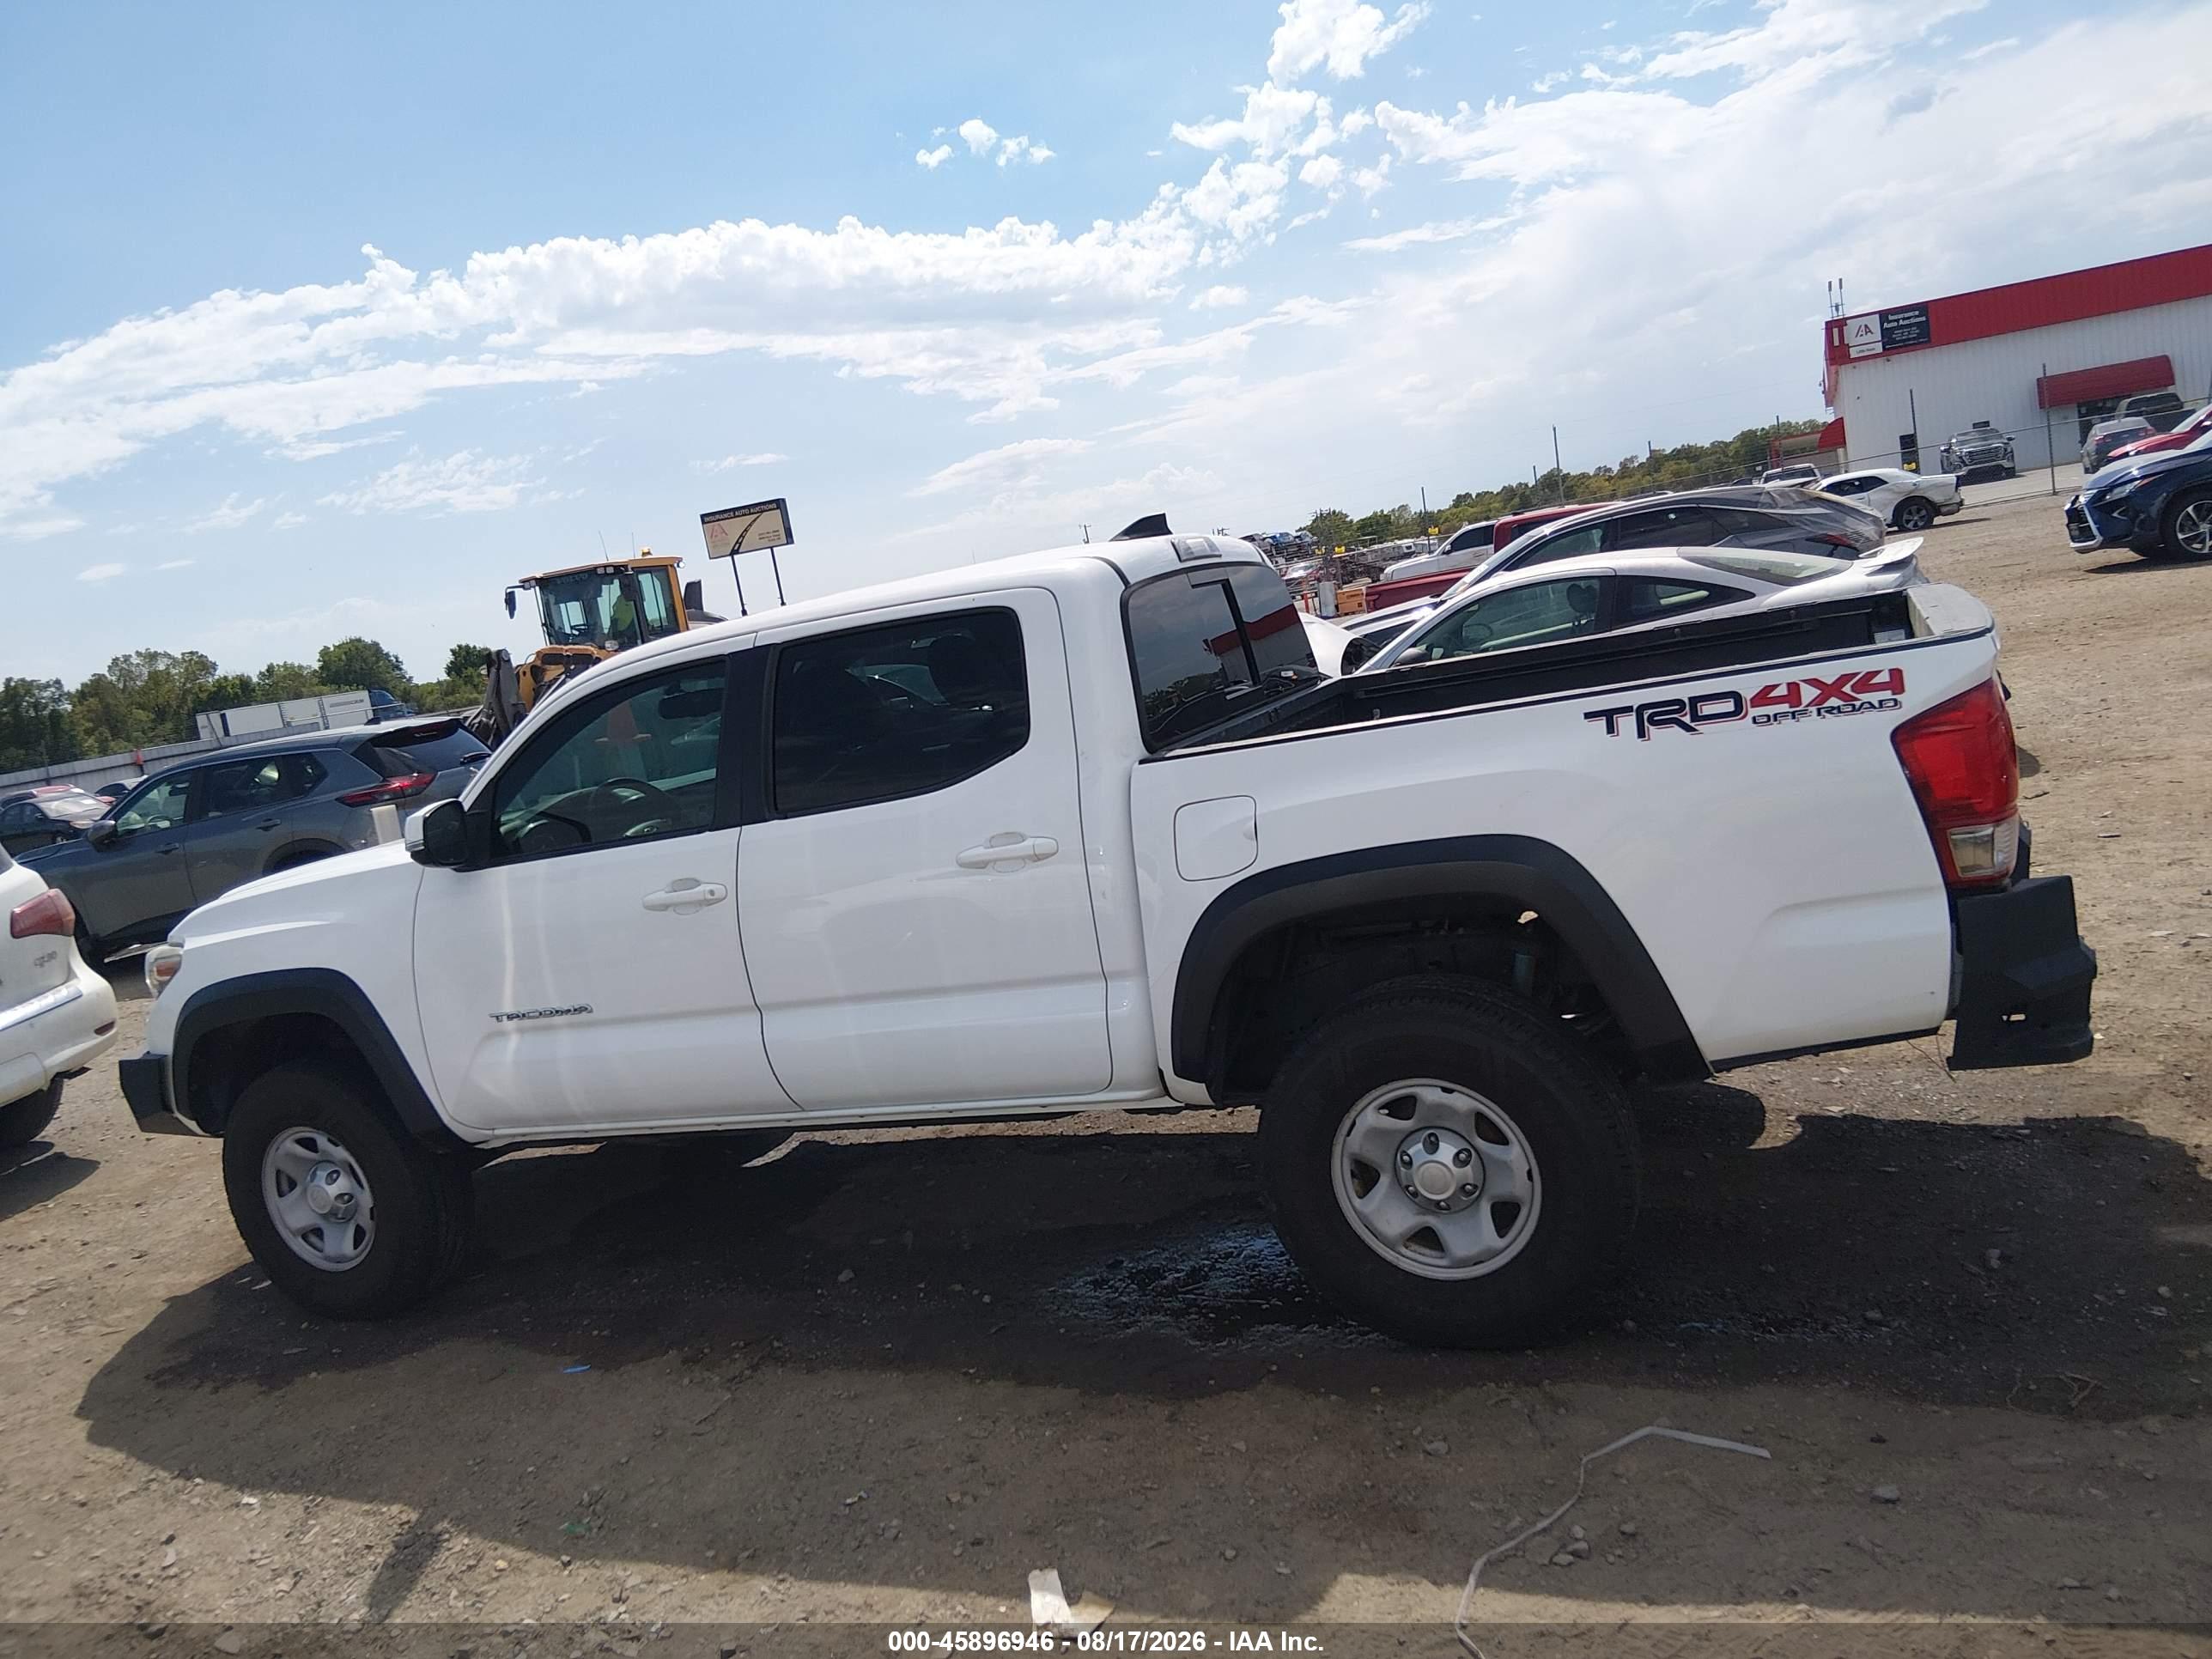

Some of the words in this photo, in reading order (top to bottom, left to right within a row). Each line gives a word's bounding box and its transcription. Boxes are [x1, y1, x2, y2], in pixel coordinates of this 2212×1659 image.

[704, 512, 734, 523] INSURANCE
[734, 508, 750, 517] AUTO
[750, 503, 777, 514] AUCTIONS
[1583, 690, 1747, 741] TRD
[1752, 708, 1809, 726] OFF
[1816, 697, 1901, 720] ROAD
[488, 1004, 593, 1023] TACOMA
